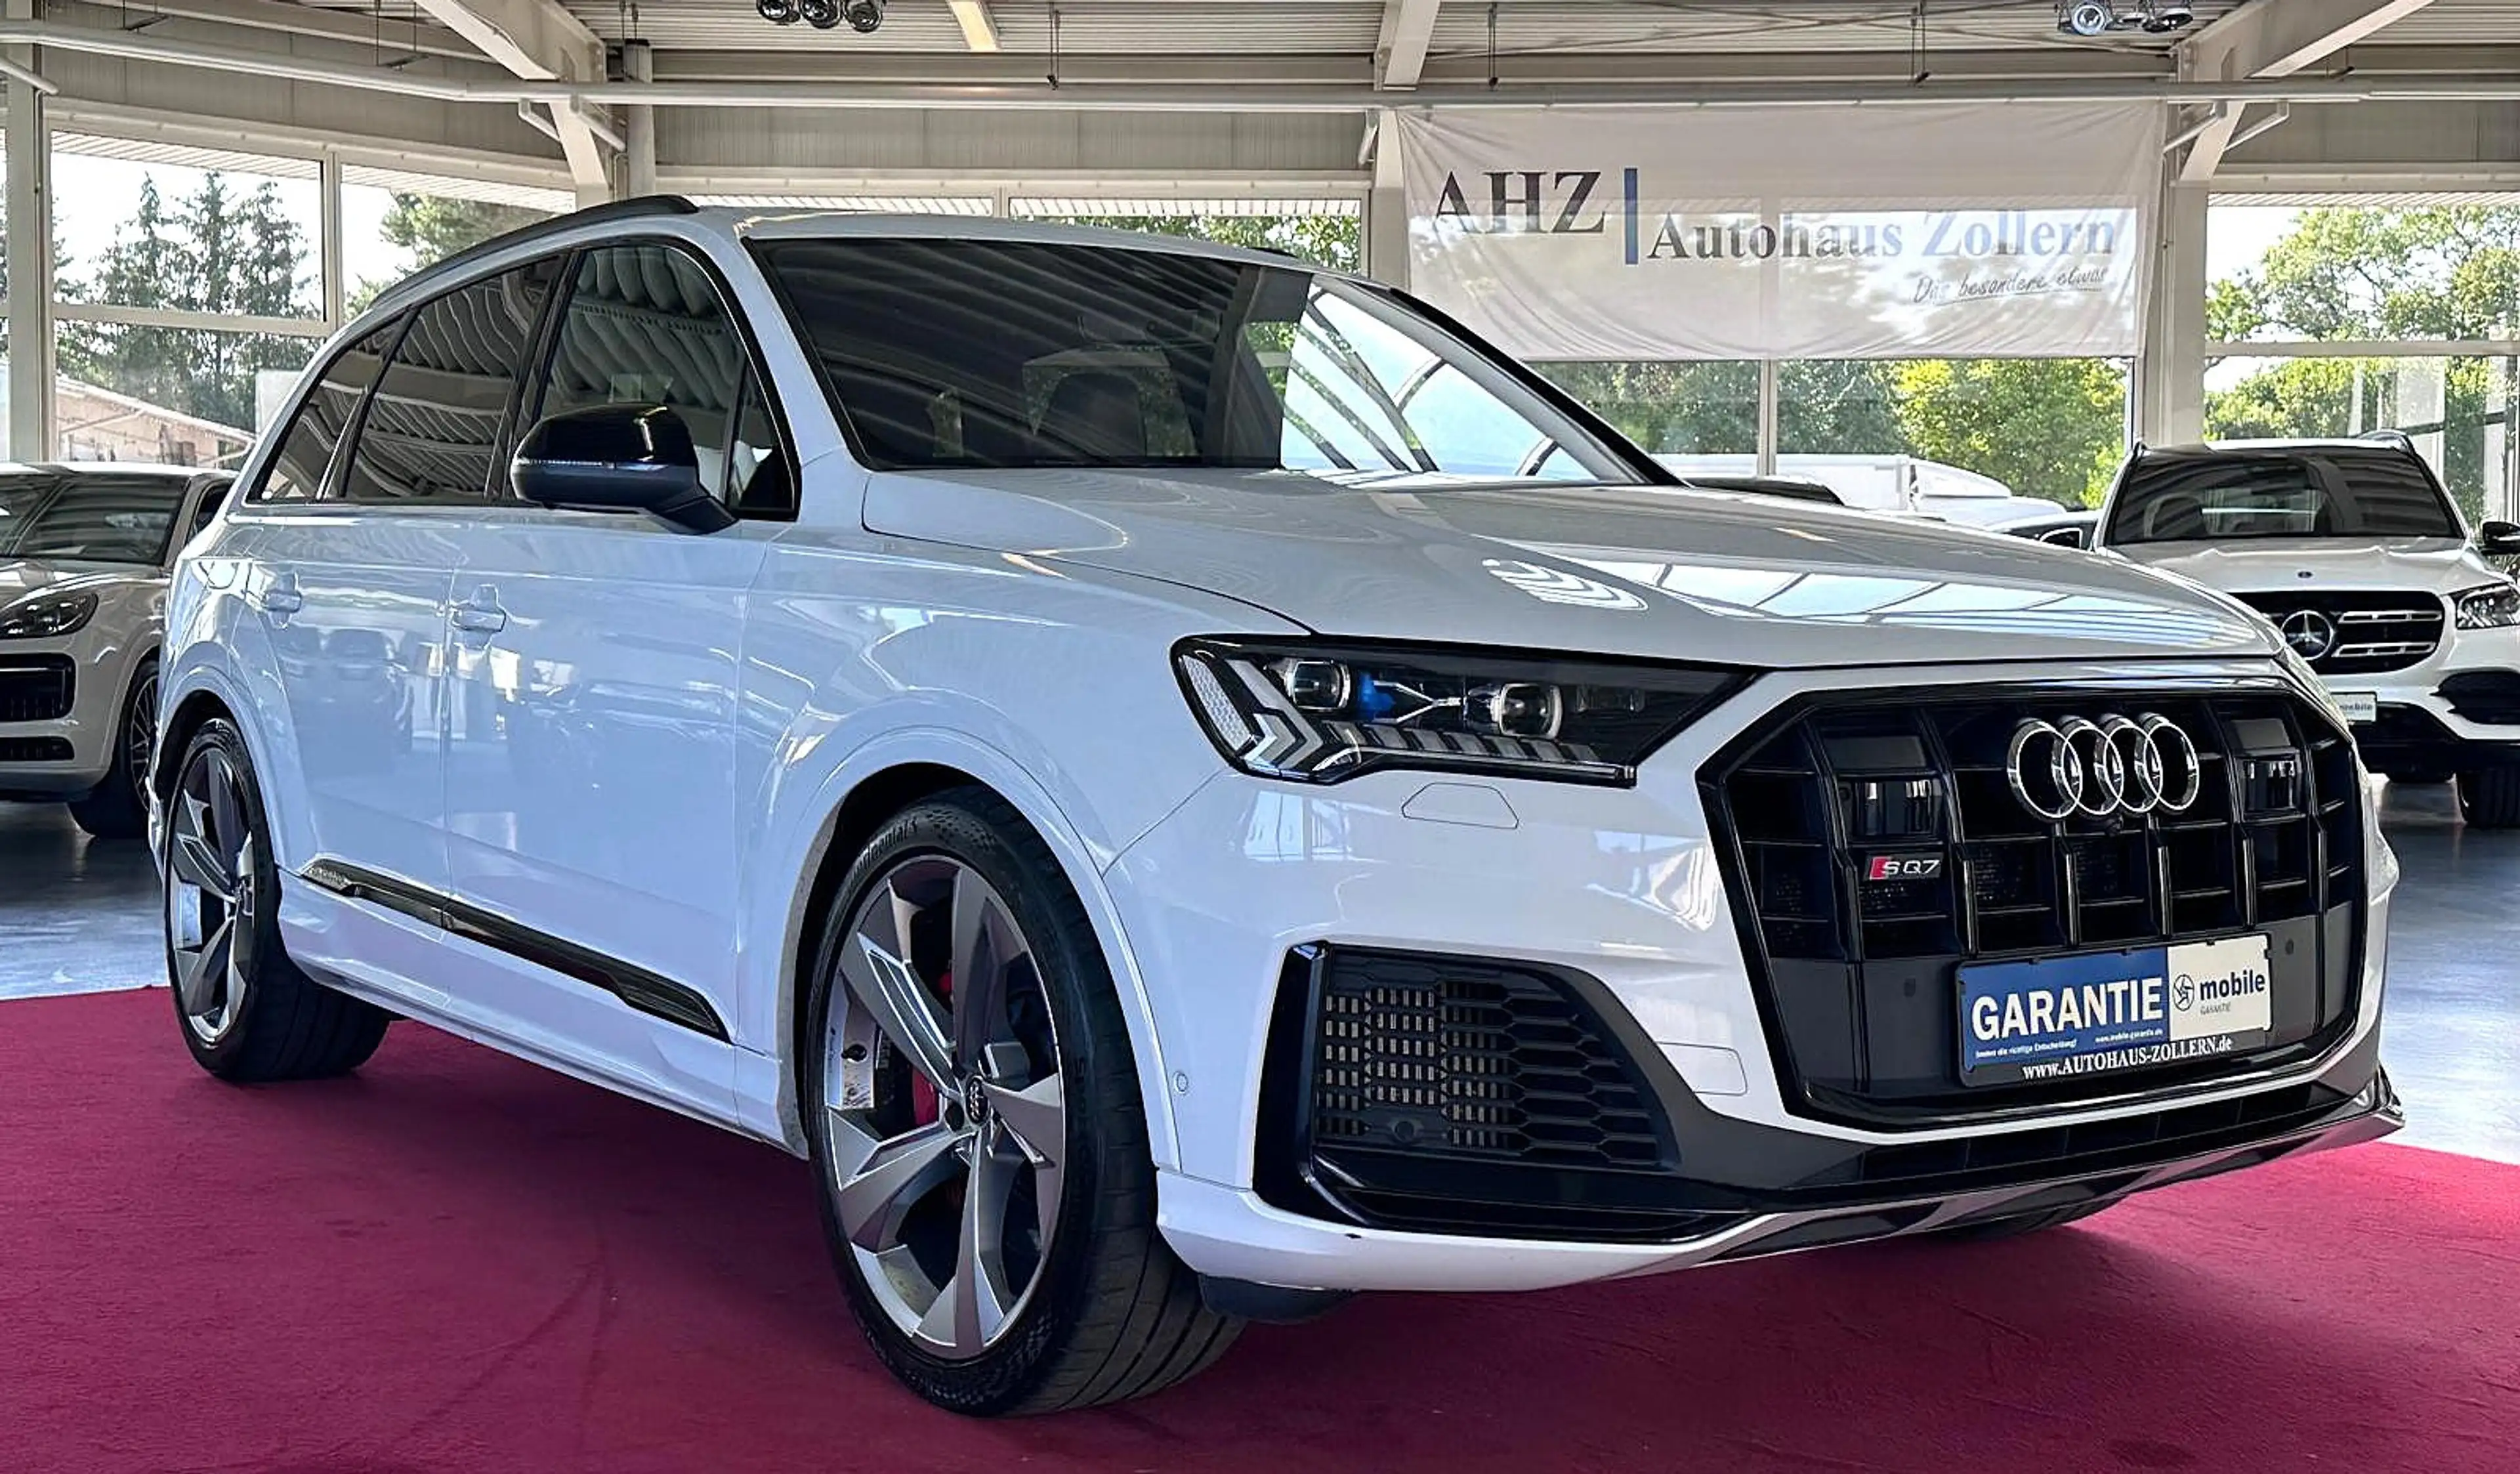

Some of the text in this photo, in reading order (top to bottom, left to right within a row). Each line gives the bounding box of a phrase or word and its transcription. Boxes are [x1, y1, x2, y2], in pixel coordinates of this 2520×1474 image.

[1433, 171, 1606, 234] AHZ
[1647, 210, 2114, 259] Autohaus Zollern
[1958, 266, 2046, 297] besondere
[1881, 859, 1940, 875] SQ7
[2200, 969, 2265, 1001] mobile
[1971, 977, 2163, 1041] GARANTIE
[2022, 1034, 2233, 1081] www.AUTOHAUS-ZOLLERN.de
